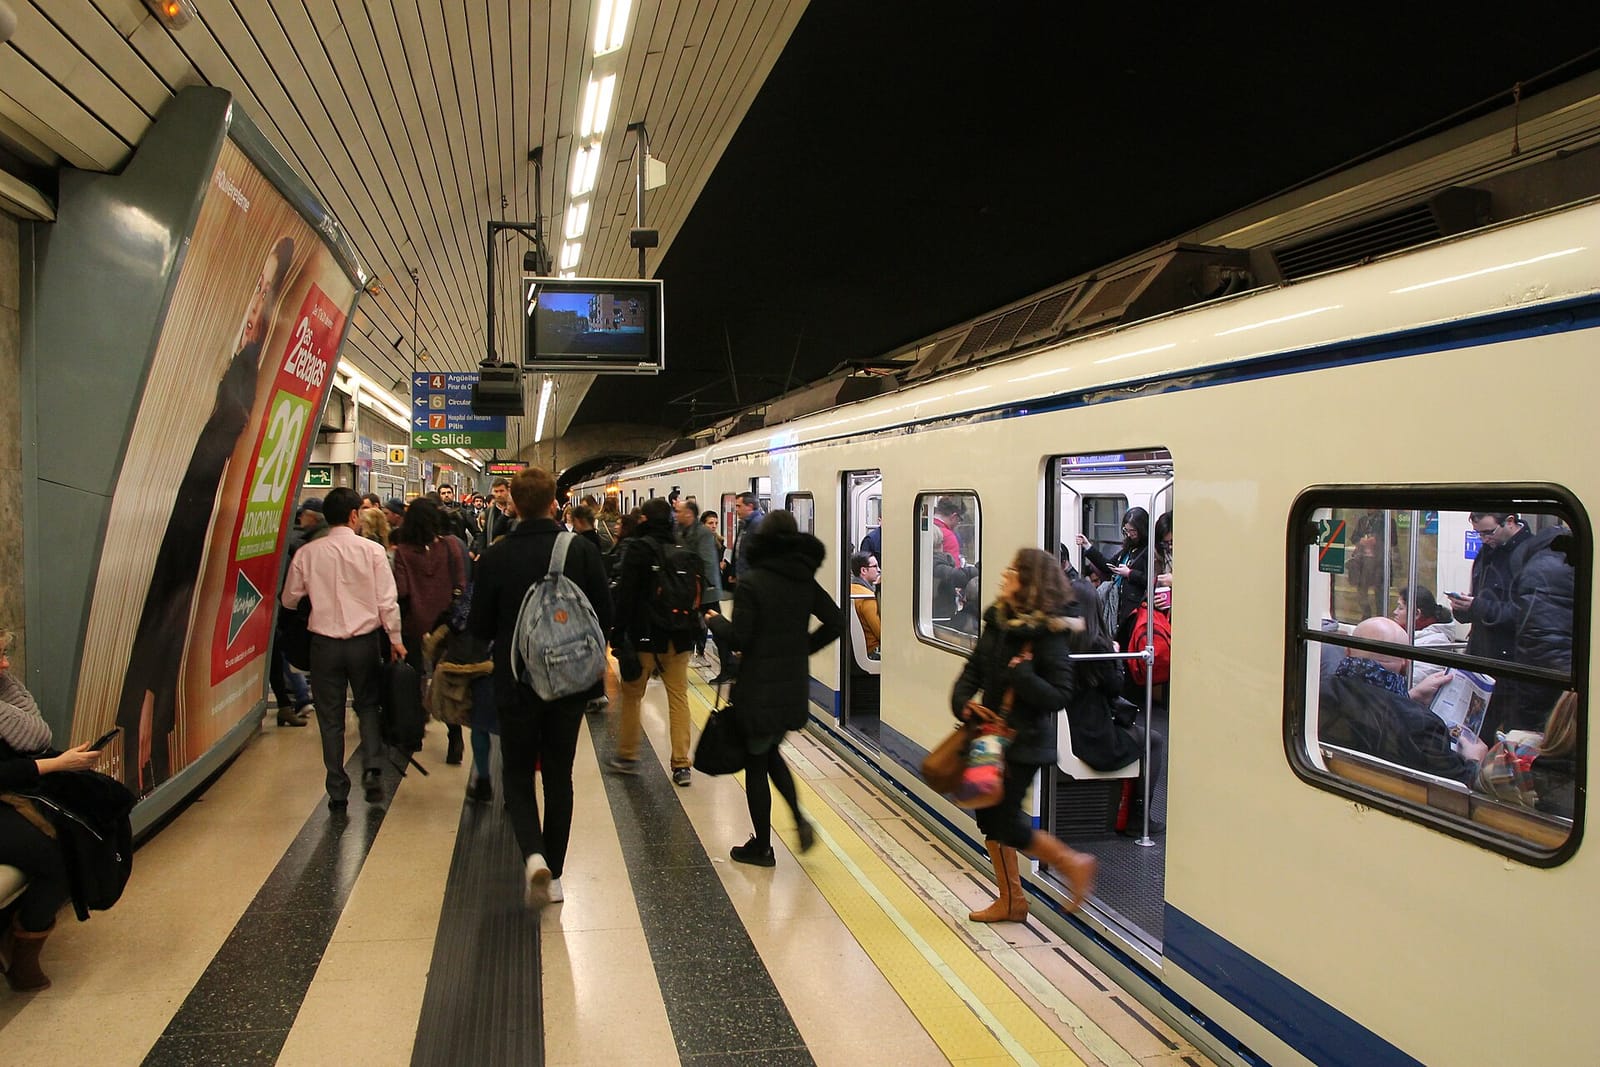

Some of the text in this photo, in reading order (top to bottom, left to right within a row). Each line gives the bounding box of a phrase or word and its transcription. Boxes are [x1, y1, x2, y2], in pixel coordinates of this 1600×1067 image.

[295, 342, 327, 391] rebajas
[432, 374, 480, 388] 4 Argüelles
[432, 396, 442, 408] 6
[433, 416, 442, 428] 7
[432, 433, 472, 445] Salida
[240, 510, 282, 538] ADICIONAL
